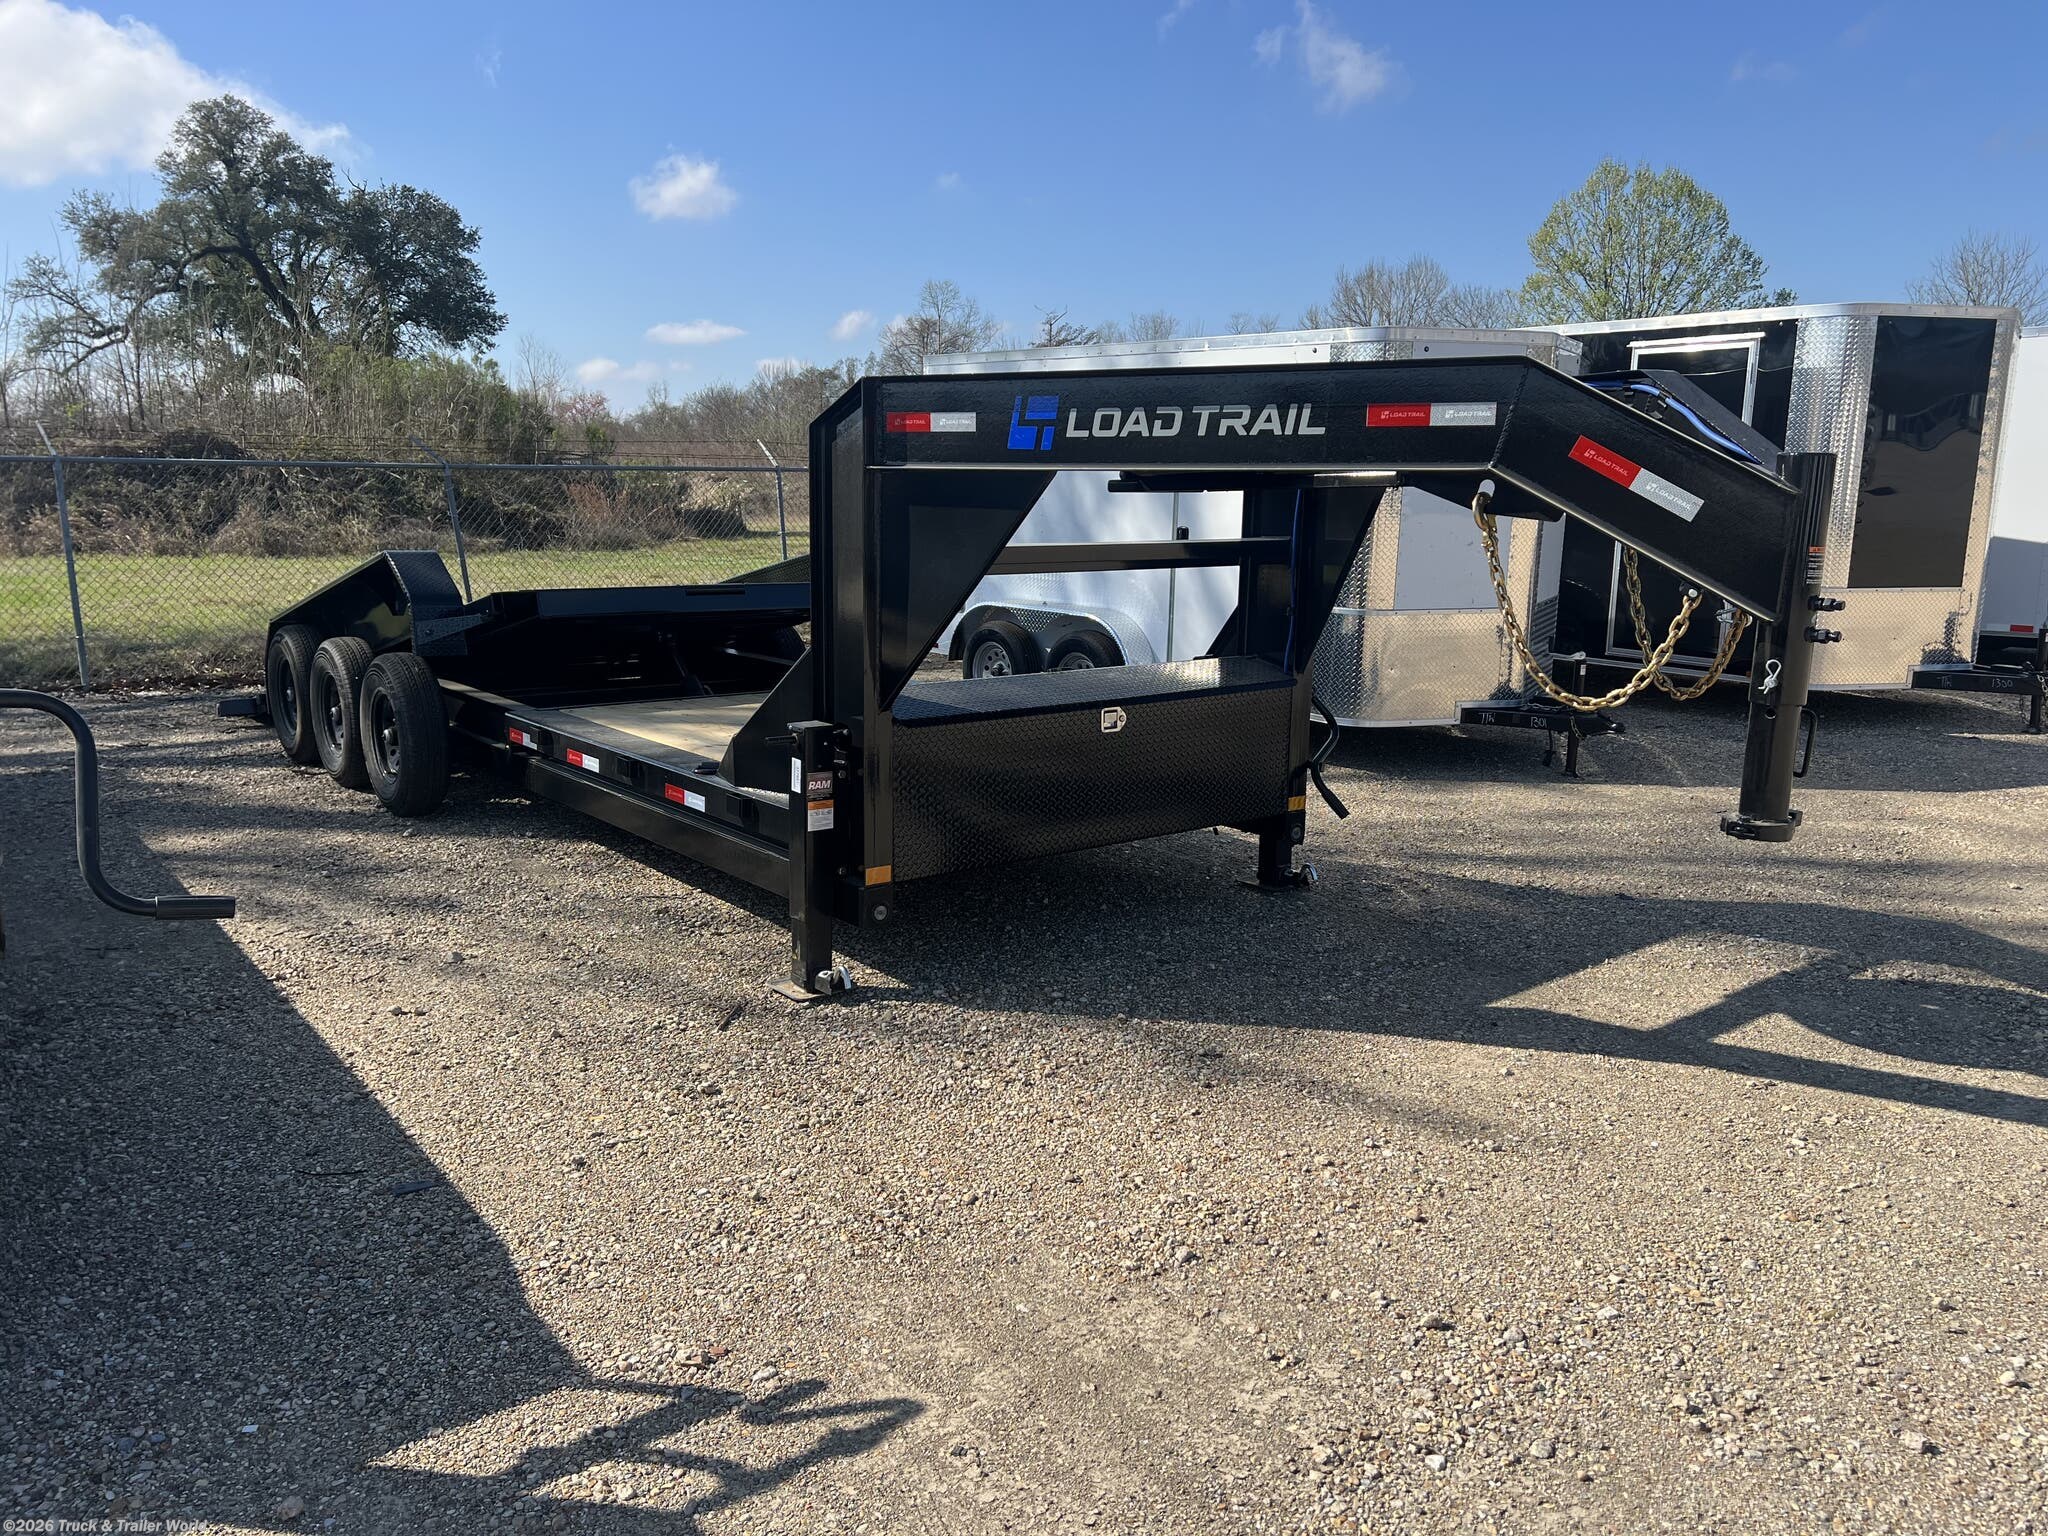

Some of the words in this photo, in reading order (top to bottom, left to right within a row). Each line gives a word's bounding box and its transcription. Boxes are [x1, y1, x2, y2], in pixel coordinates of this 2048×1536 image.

[1065, 407, 1184, 438] LOAD
[1191, 403, 1327, 436] TRAIL
[1594, 454, 1611, 466] LOAD
[1610, 463, 1629, 477] TRAIL
[1655, 487, 1674, 500] LOAD
[1672, 496, 1692, 511] TRAIL
[808, 780, 831, 790] RAM
